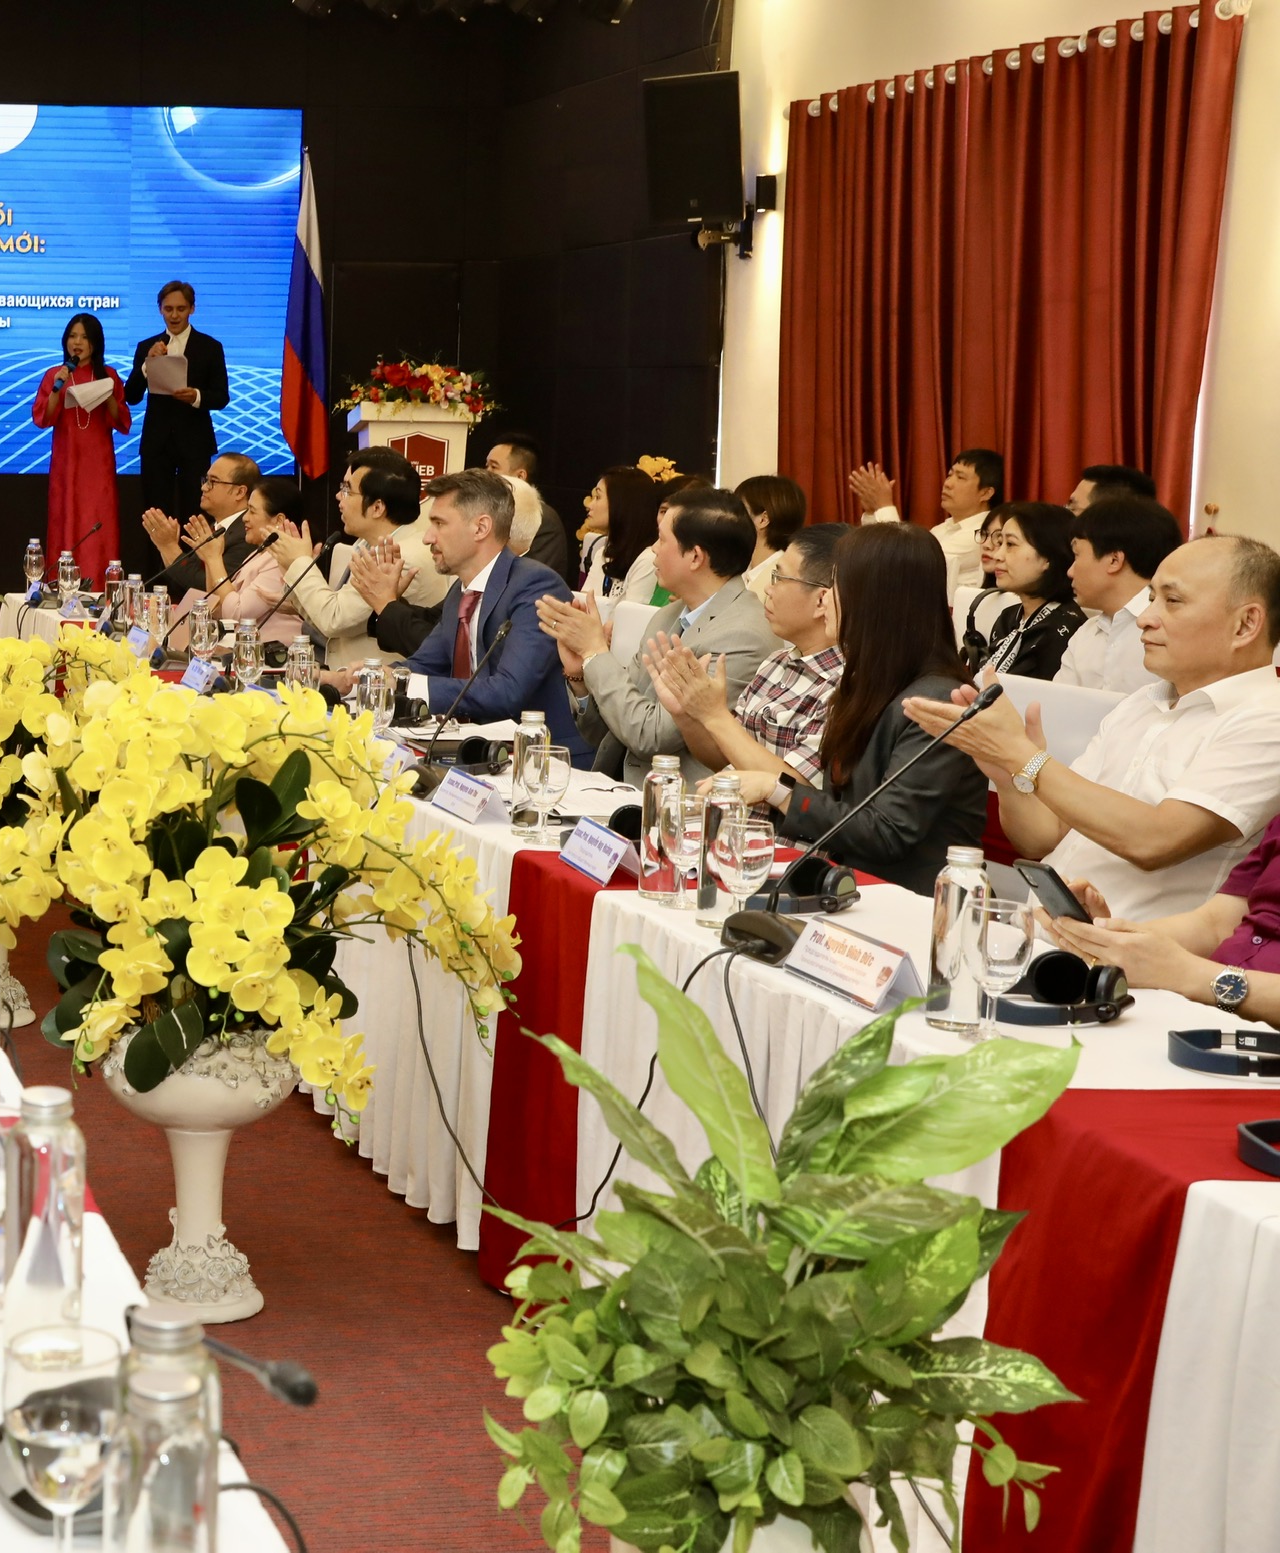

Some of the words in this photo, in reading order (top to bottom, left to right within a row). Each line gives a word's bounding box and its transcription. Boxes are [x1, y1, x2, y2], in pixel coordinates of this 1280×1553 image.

[78, 296, 120, 310] стран
[810, 930, 826, 945] Prof.
[824, 936, 848, 955] Nguyễn
